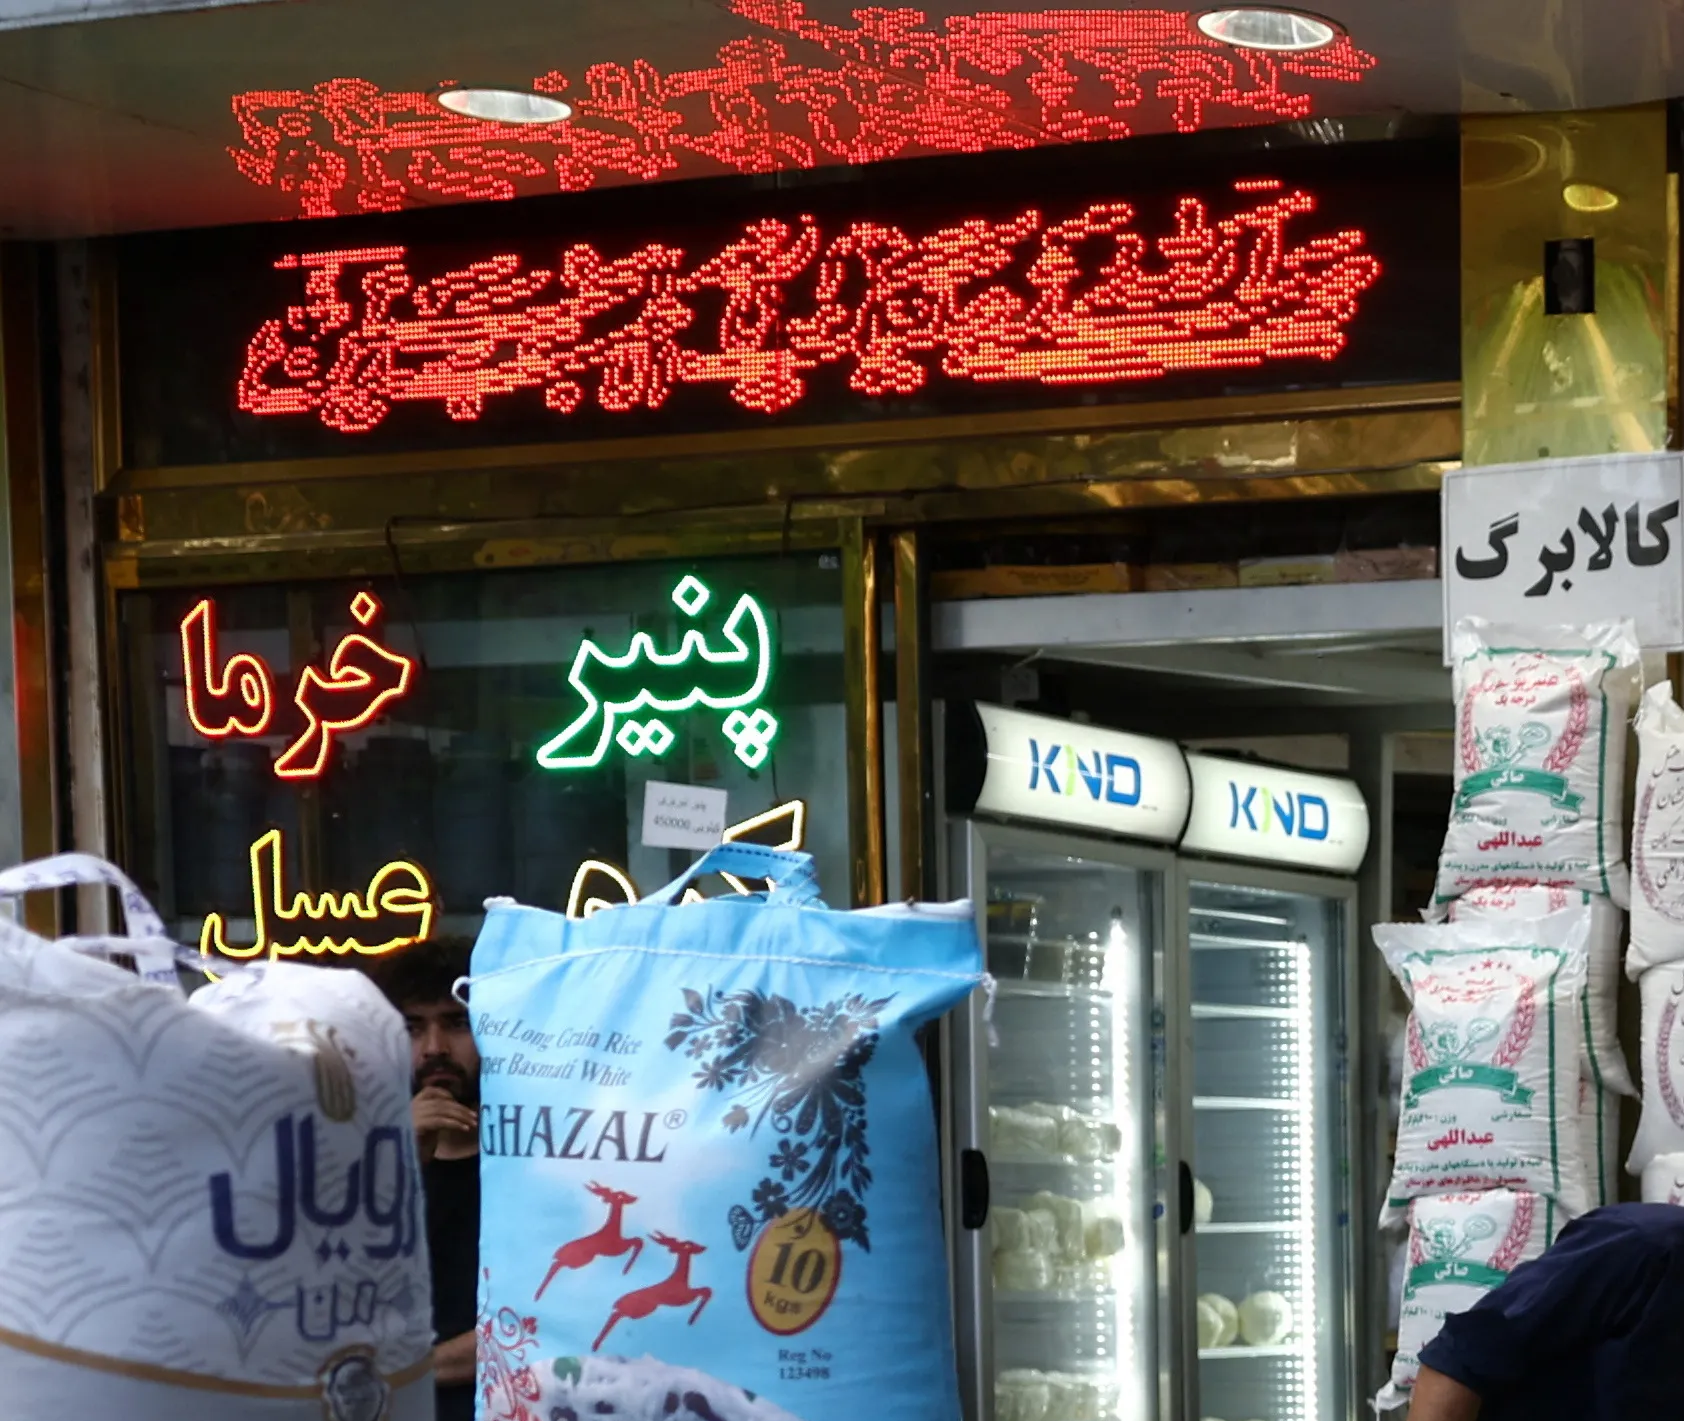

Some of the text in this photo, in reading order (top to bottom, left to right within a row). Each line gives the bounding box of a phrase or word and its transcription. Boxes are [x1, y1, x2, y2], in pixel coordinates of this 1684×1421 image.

[1455, 498, 1680, 598] کالابرگ
[181, 591, 411, 778] خرما
[536, 575, 777, 768] پنیر
[200, 829, 434, 980] عسل
[476, 1013, 644, 1055] Best Long Grain Rice
[507, 1053, 633, 1087] Basmati White
[1427, 1129, 1494, 1151] عبداللهی
[765, 1241, 827, 1294] 10
[778, 1349, 832, 1362] Reg No
